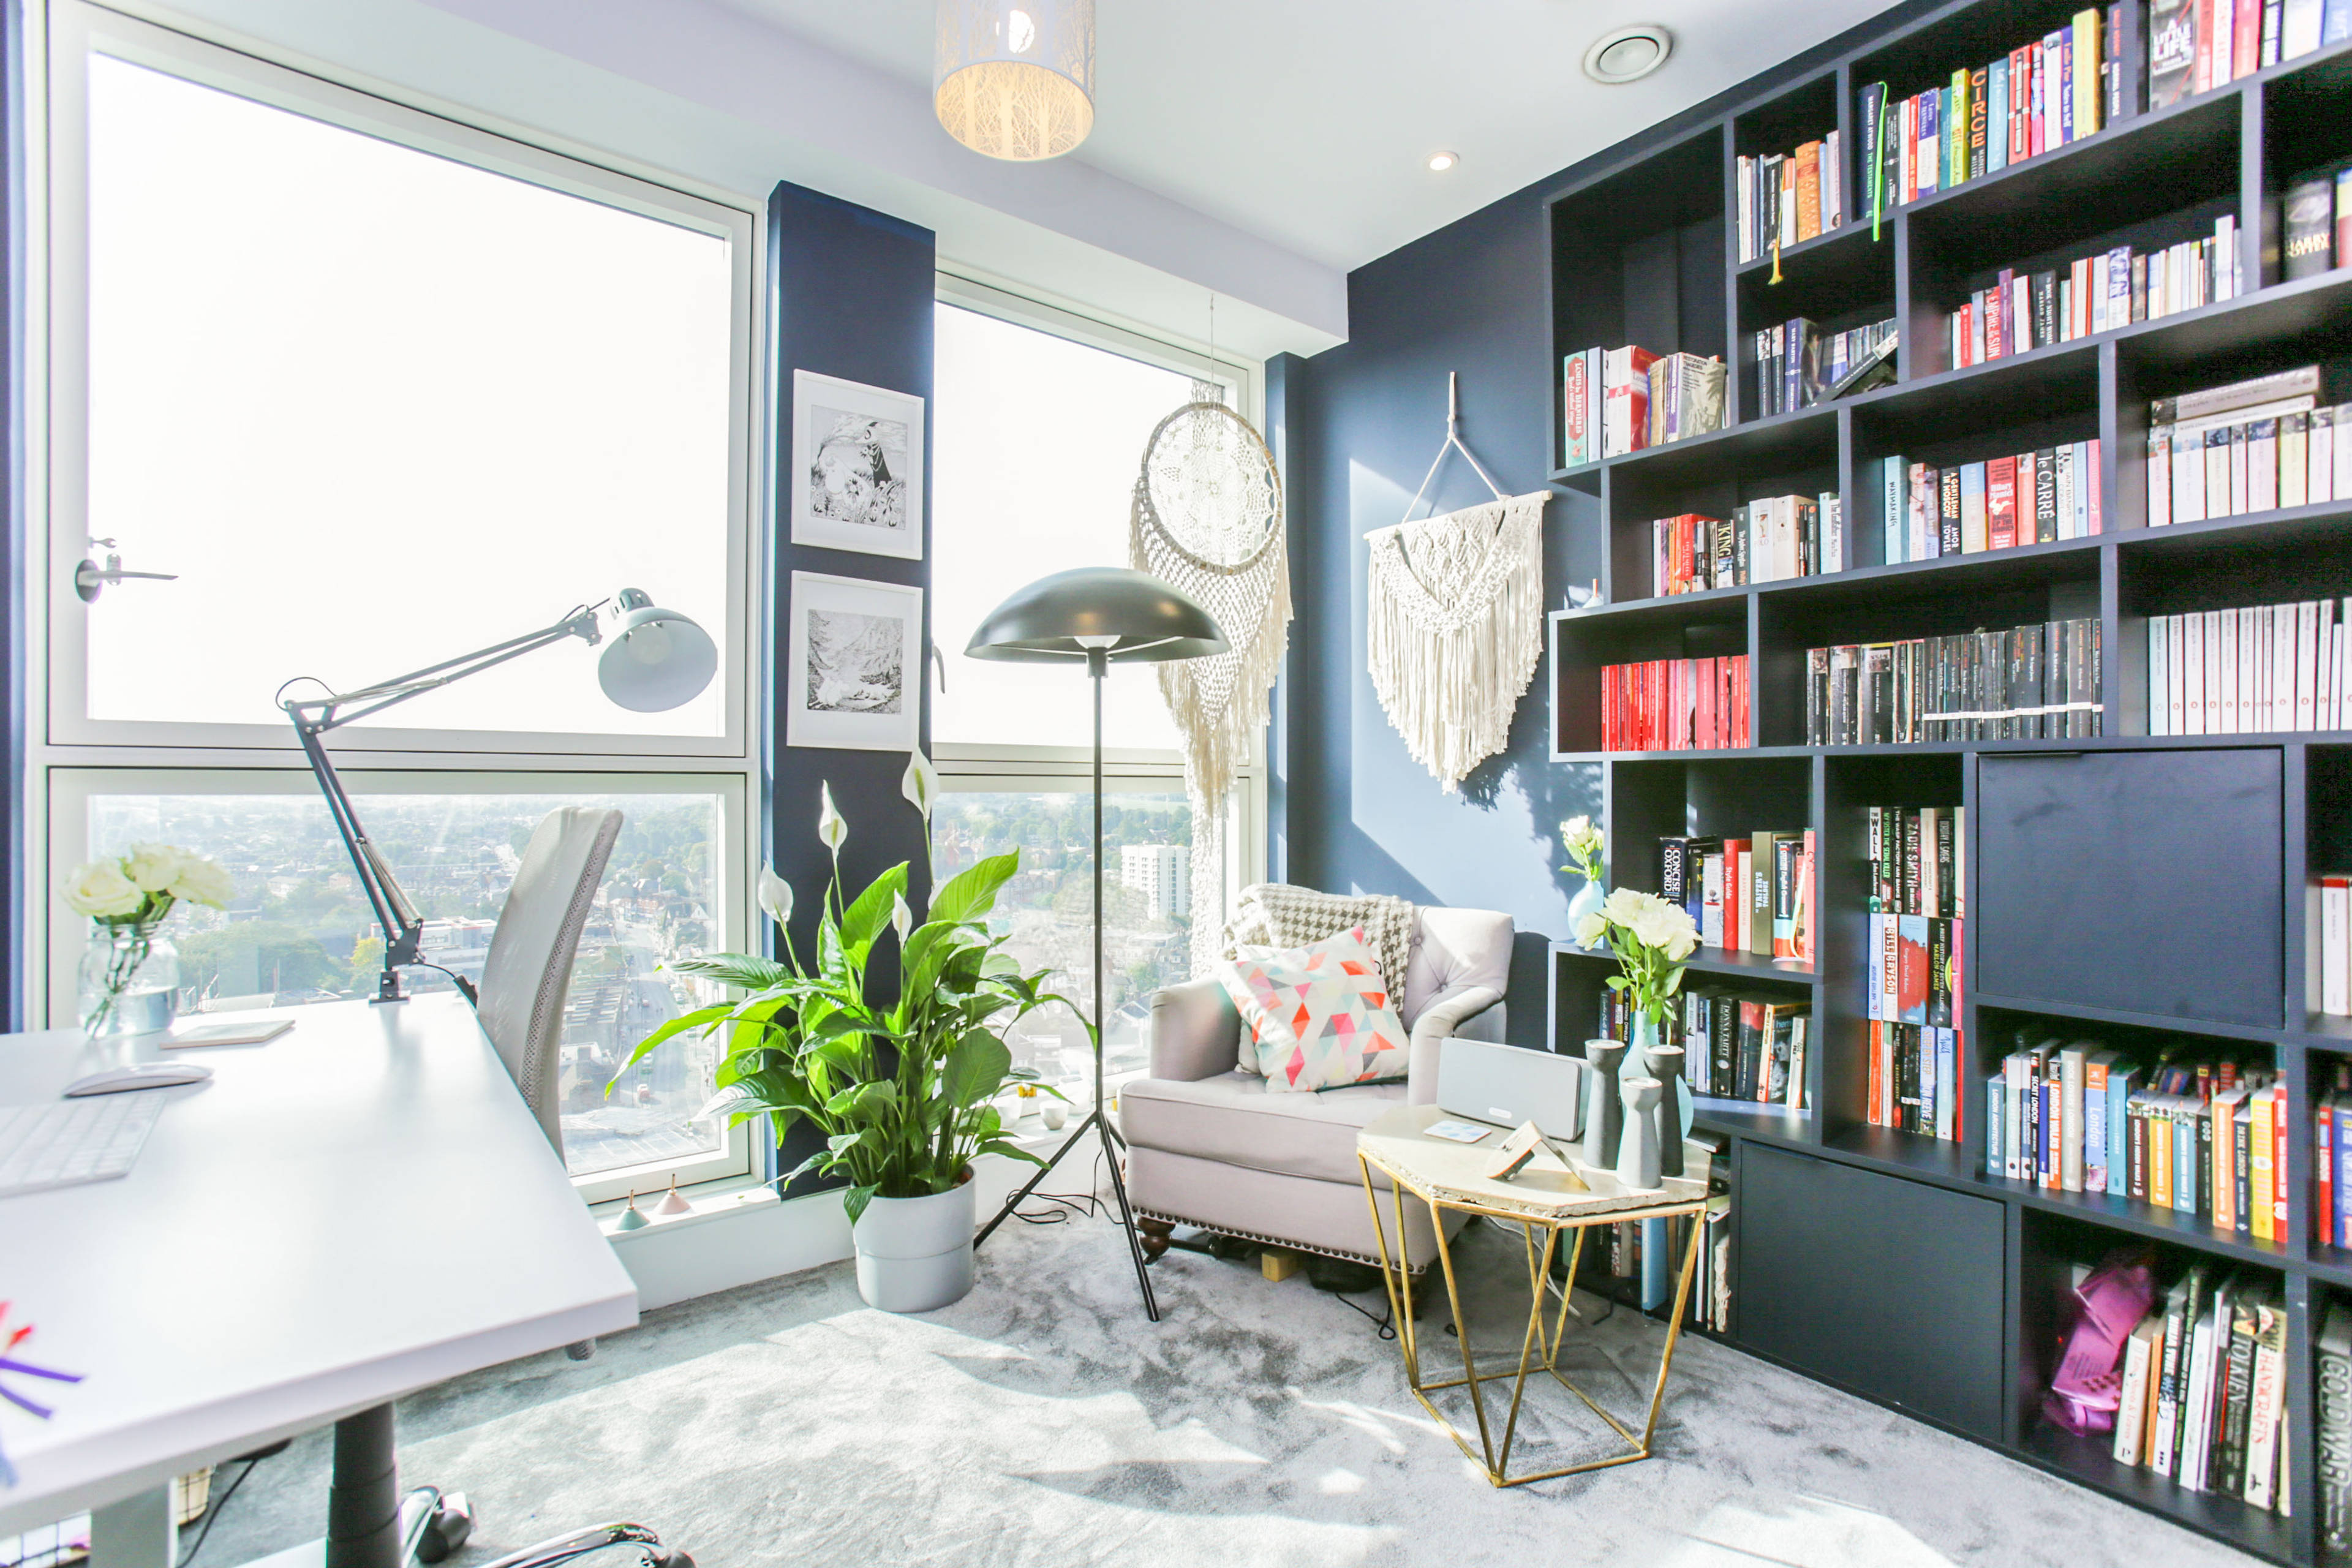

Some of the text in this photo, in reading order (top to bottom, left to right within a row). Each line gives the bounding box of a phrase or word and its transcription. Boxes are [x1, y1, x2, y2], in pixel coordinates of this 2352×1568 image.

[2154, 23, 2192, 48] LITTLE
[2154, 36, 2192, 61] LIFE
[1970, 70, 1988, 148] CIRCE
[1986, 295, 2000, 331] EMPIRE
[1988, 337, 2000, 358] SUN
[1888, 481, 1897, 527] WAYMAKING
[2037, 456, 2056, 520] le CARRÉ
[1831, 504, 1840, 537] The Godfather
[1718, 526, 1732, 557] KING
[1871, 818, 1879, 854] WALL
[1940, 821, 1950, 840] DOROTHY
[1664, 849, 1672, 892] OXFORD
[1672, 849, 1681, 892] CONCISE
[1907, 823, 1918, 888] ZADIE SMITH
[1940, 846, 1950, 863] SAYERS
[1885, 927, 1896, 994] BILL BRYSON
[1722, 1005, 1731, 1058] DONNA TARTT
[1923, 1031, 1932, 1047] STEP
[1940, 1036, 1951, 1054] Wild
[1923, 1059, 1932, 1075] STEP
[2050, 1084, 2061, 1149] LONDON WALKS
[2089, 1107, 2101, 1147] London
[2163, 1314, 2180, 1376] NINJA TUNE
[2228, 1336, 2252, 1406] TOLKIEN
[2250, 1317, 2282, 1445] HOME HANDICRAFTS
[2320, 1425, 2351, 1487] WAR
